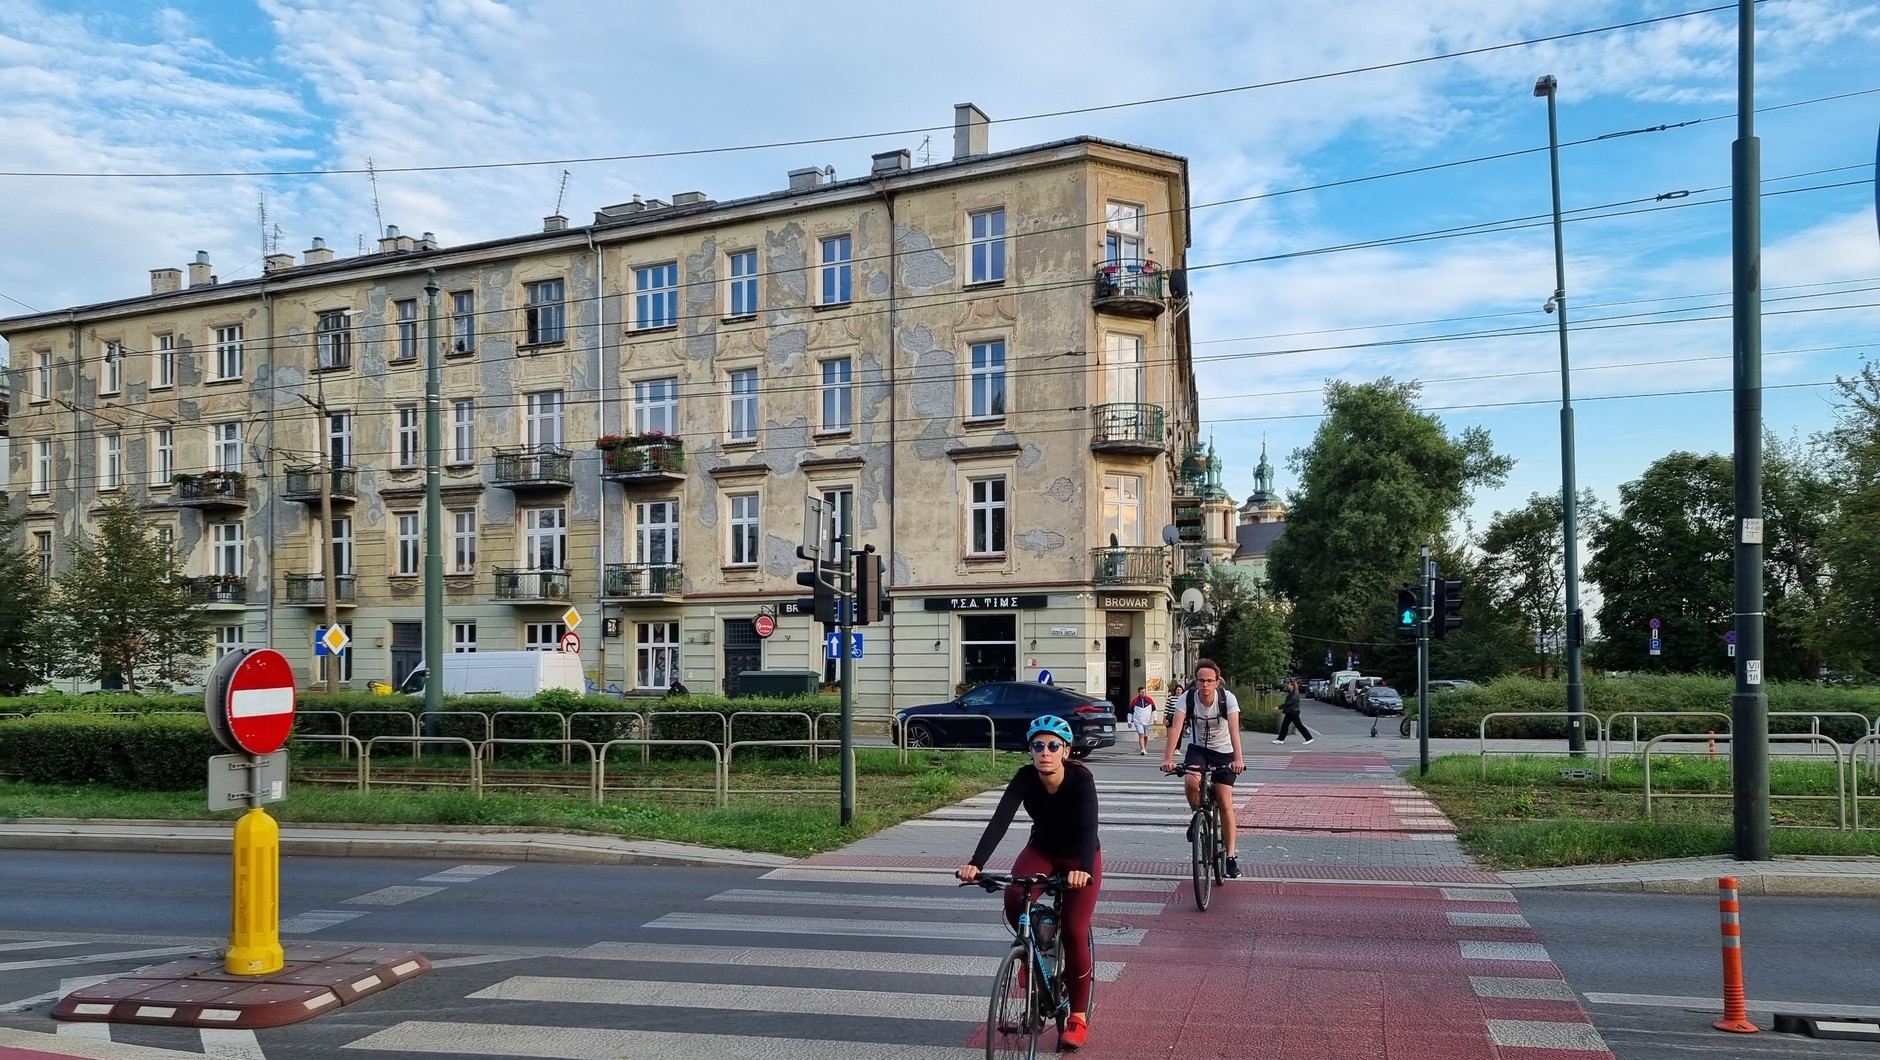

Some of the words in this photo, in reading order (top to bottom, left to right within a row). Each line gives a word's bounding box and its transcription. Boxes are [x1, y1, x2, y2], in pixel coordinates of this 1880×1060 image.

[984, 597, 1018, 608] TIME
[1105, 597, 1148, 607] BROWAR
[1748, 661, 1760, 669] VII
